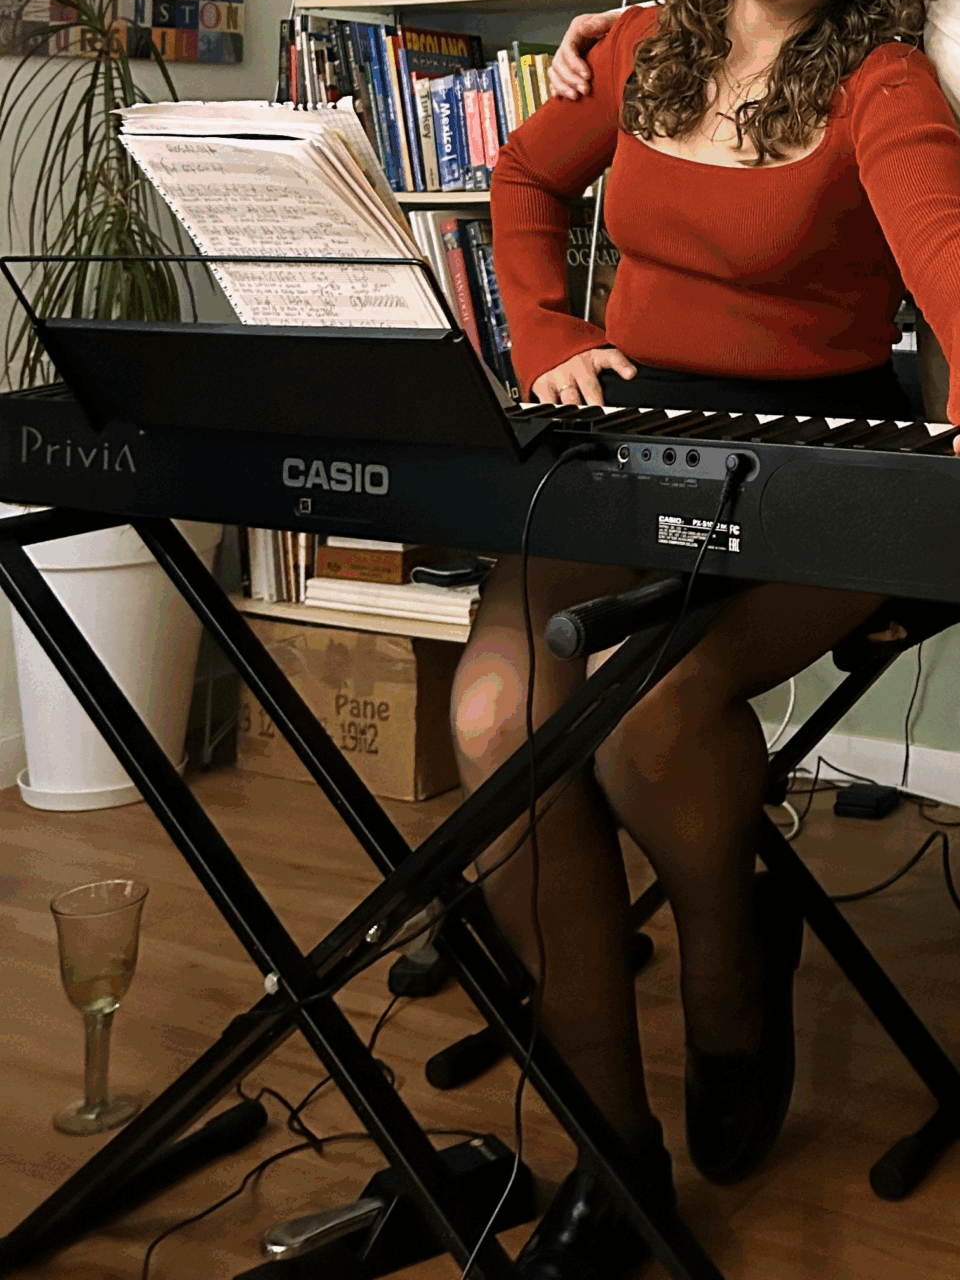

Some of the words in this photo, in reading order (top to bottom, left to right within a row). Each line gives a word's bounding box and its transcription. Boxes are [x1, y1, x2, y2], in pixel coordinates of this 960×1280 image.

[420, 93, 431, 139] Turkey
[440, 103, 452, 152] Mexico
[282, 457, 390, 495] CASIO
[658, 515, 684, 525] CASIO
[334, 693, 390, 721] Pane
